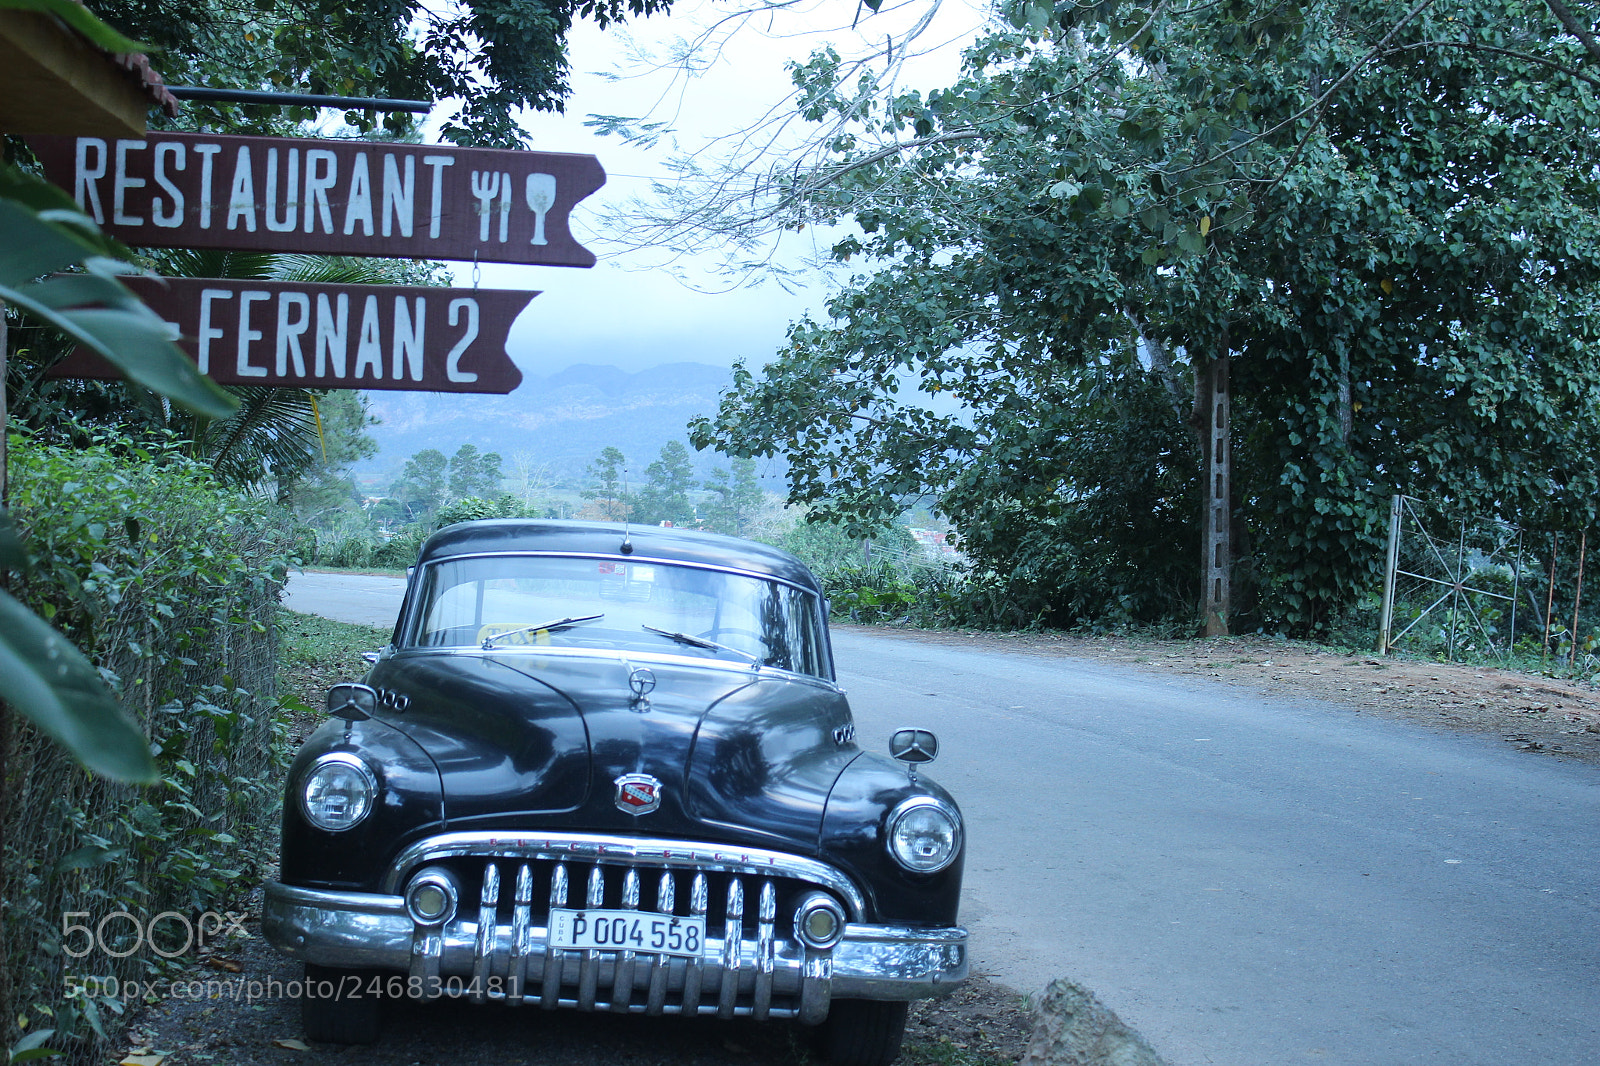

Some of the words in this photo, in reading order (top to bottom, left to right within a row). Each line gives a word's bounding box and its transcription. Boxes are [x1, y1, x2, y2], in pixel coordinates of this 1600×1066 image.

[75, 136, 455, 240] RESTAURANT
[198, 288, 426, 382] FERNAN
[446, 298, 479, 383] 2
[489, 838, 606, 854] BUICK
[662, 849, 775, 866] EIGHT
[557, 915, 565, 942] CUBA
[572, 917, 587, 944] P
[594, 917, 643, 946] 004
[651, 920, 700, 952] 558
